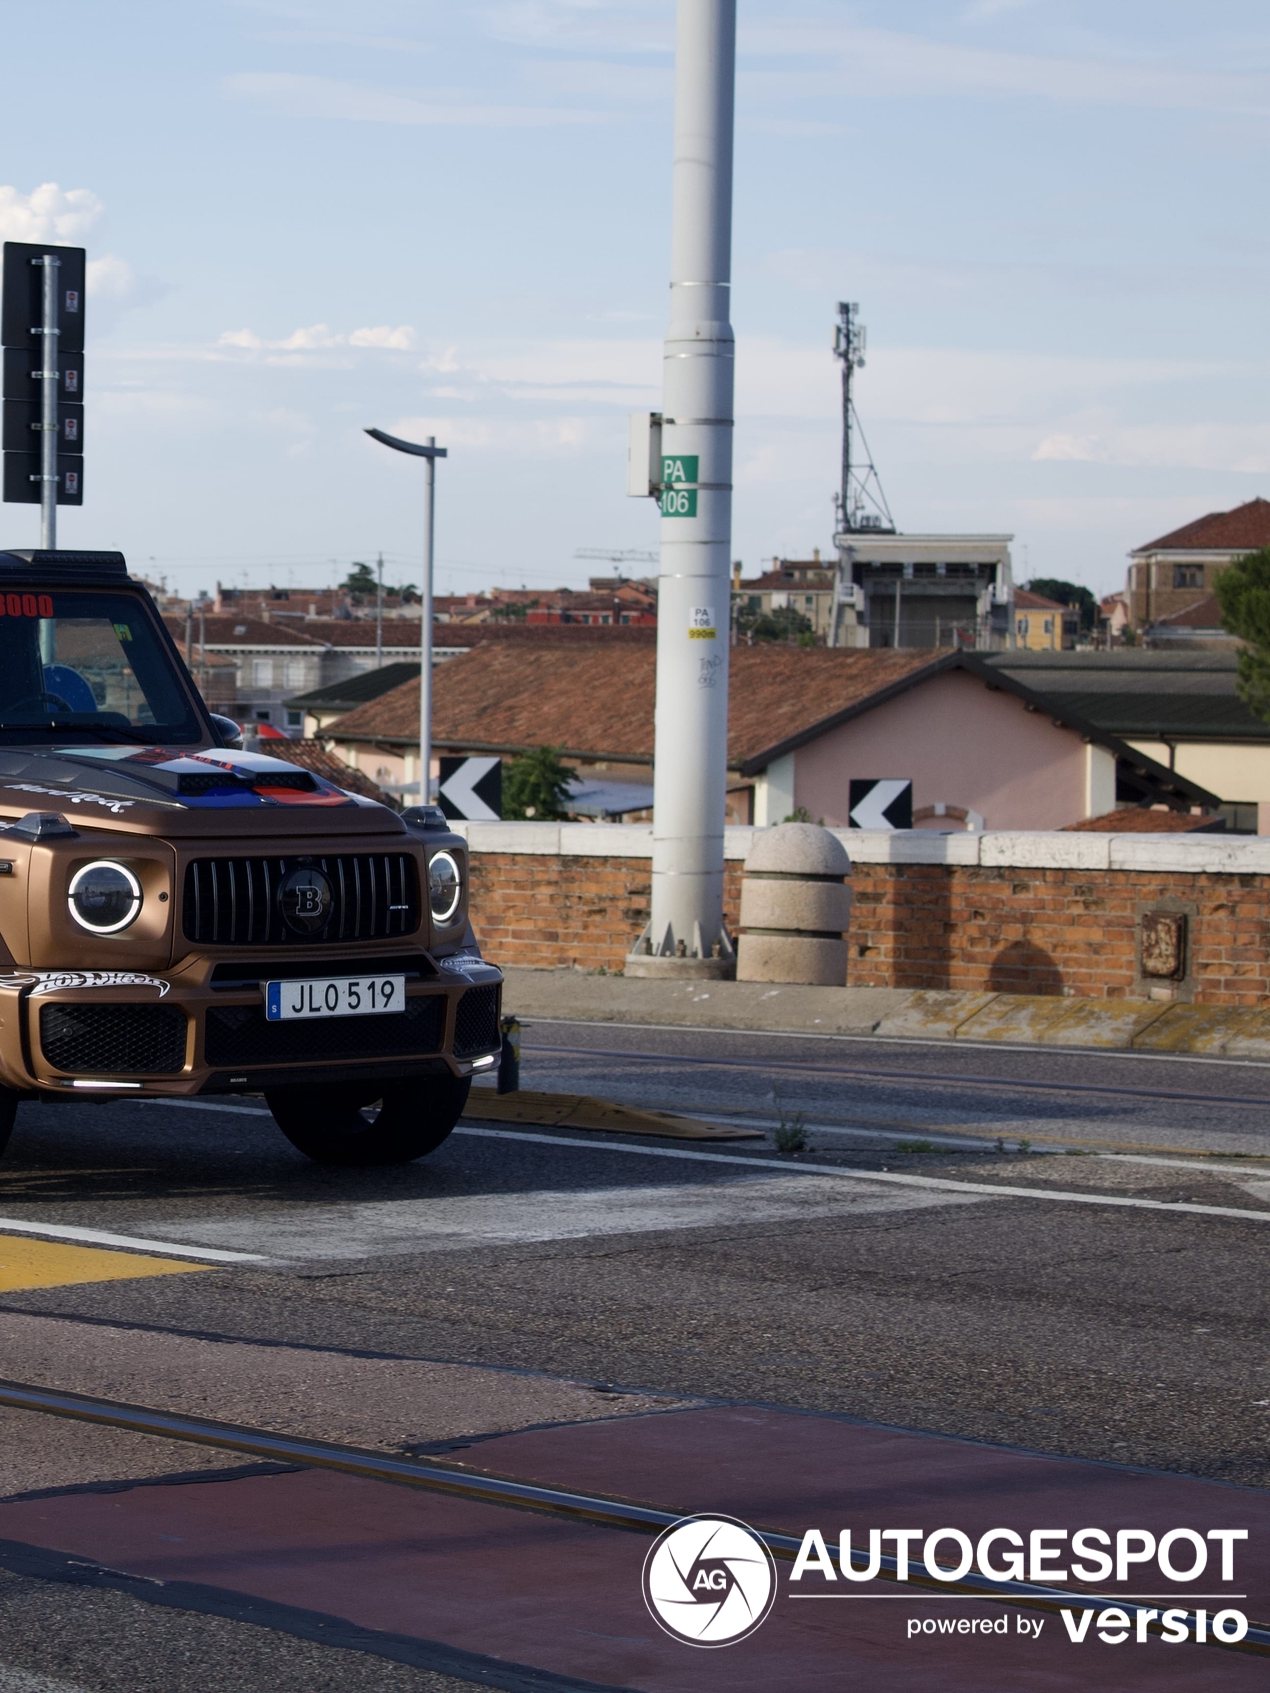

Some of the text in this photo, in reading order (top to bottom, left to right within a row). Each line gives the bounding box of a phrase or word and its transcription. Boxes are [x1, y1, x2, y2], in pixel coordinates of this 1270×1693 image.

[663, 459, 687, 482] PA
[661, 491, 690, 514] 106
[693, 618, 711, 627] 106
[695, 608, 709, 617] PA
[295, 885, 323, 916] B
[347, 980, 396, 1010] 519
[271, 1004, 278, 1013] S
